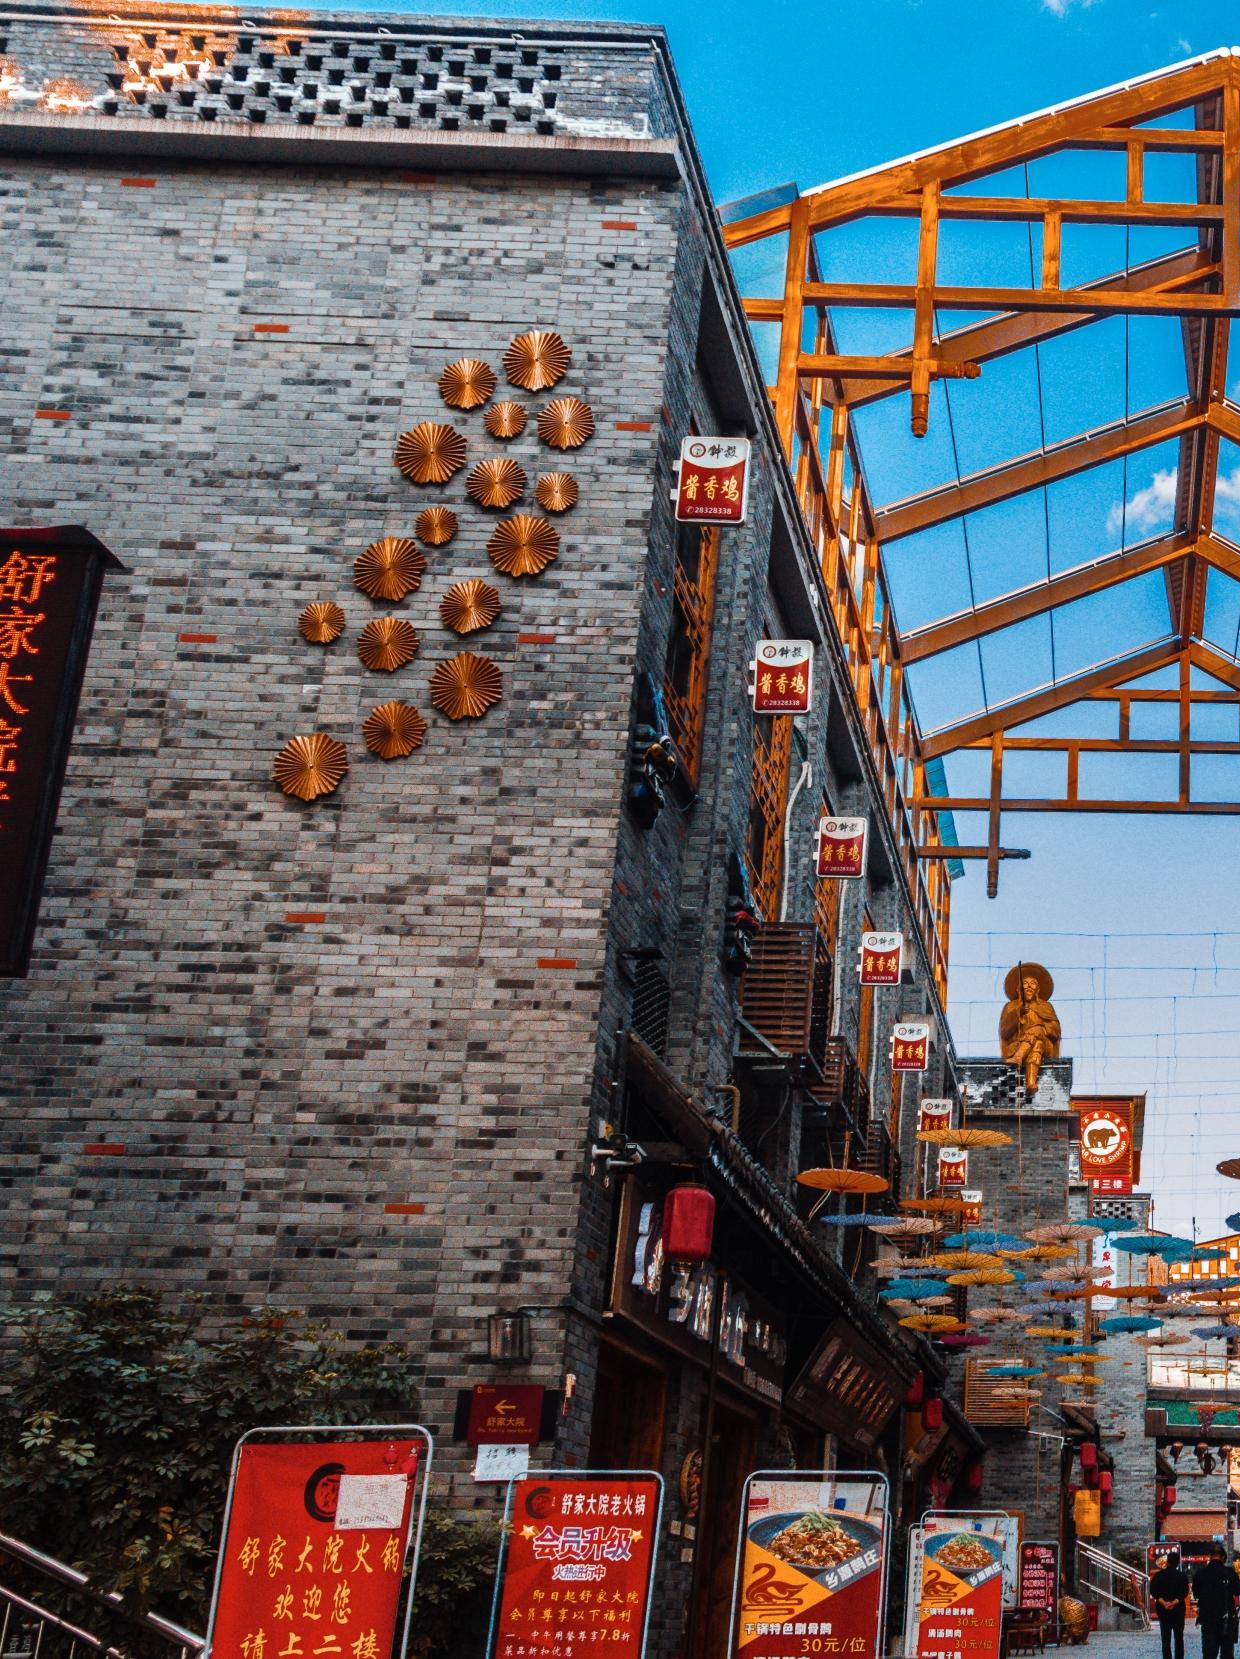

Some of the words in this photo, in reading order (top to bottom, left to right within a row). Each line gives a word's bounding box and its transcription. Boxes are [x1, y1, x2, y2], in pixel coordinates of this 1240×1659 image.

[682, 474, 740, 501] 酱香鸡
[758, 672, 806, 694] 酱香鸡
[822, 843, 861, 862] 酱香鸡
[864, 956, 898, 972] 酱香鸡
[1089, 1154, 1106, 1163] LOVE
[1108, 1140, 1127, 1162] SHRIMP
[561, 1493, 646, 1516] 舒家大院老火锅
[533, 1525, 632, 1561] 会员升级
[237, 1534, 400, 1577] 舒家大院火锅
[552, 1564, 606, 1581] 火热进行中
[273, 1579, 351, 1625] 欢迎您
[533, 1589, 639, 1604] 即日起舒家大院
[510, 1608, 631, 1622] 会员尊享以下福利
[956, 1618, 994, 1627] 30元/位
[240, 1628, 380, 1659] 请上二楼
[504, 1645, 574, 1657] 菜品折扣优惠
[800, 1637, 866, 1652] 30元/位
[955, 1640, 993, 1649] 30元/位
